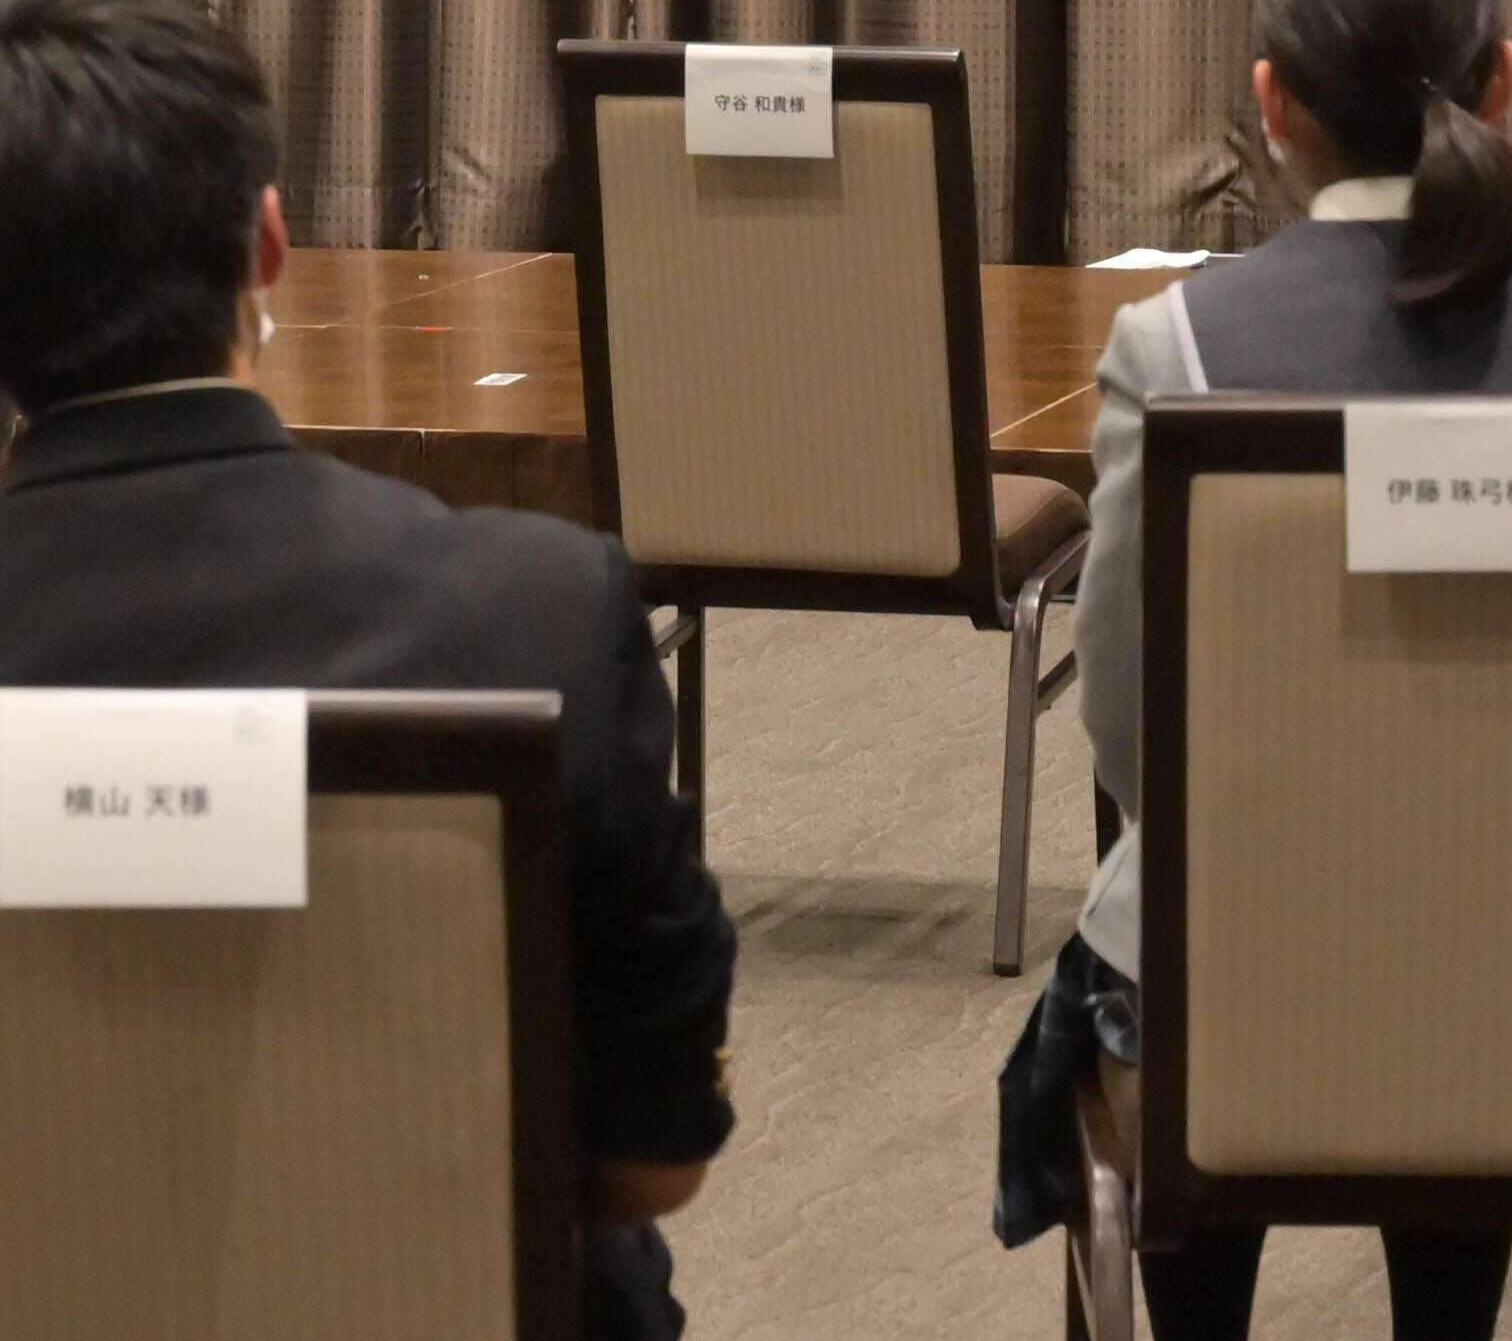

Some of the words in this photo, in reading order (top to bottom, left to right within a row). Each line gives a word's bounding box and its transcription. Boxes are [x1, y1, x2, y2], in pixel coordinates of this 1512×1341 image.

[714, 94, 748, 112] 守谷
[754, 95, 806, 114] 和貴様
